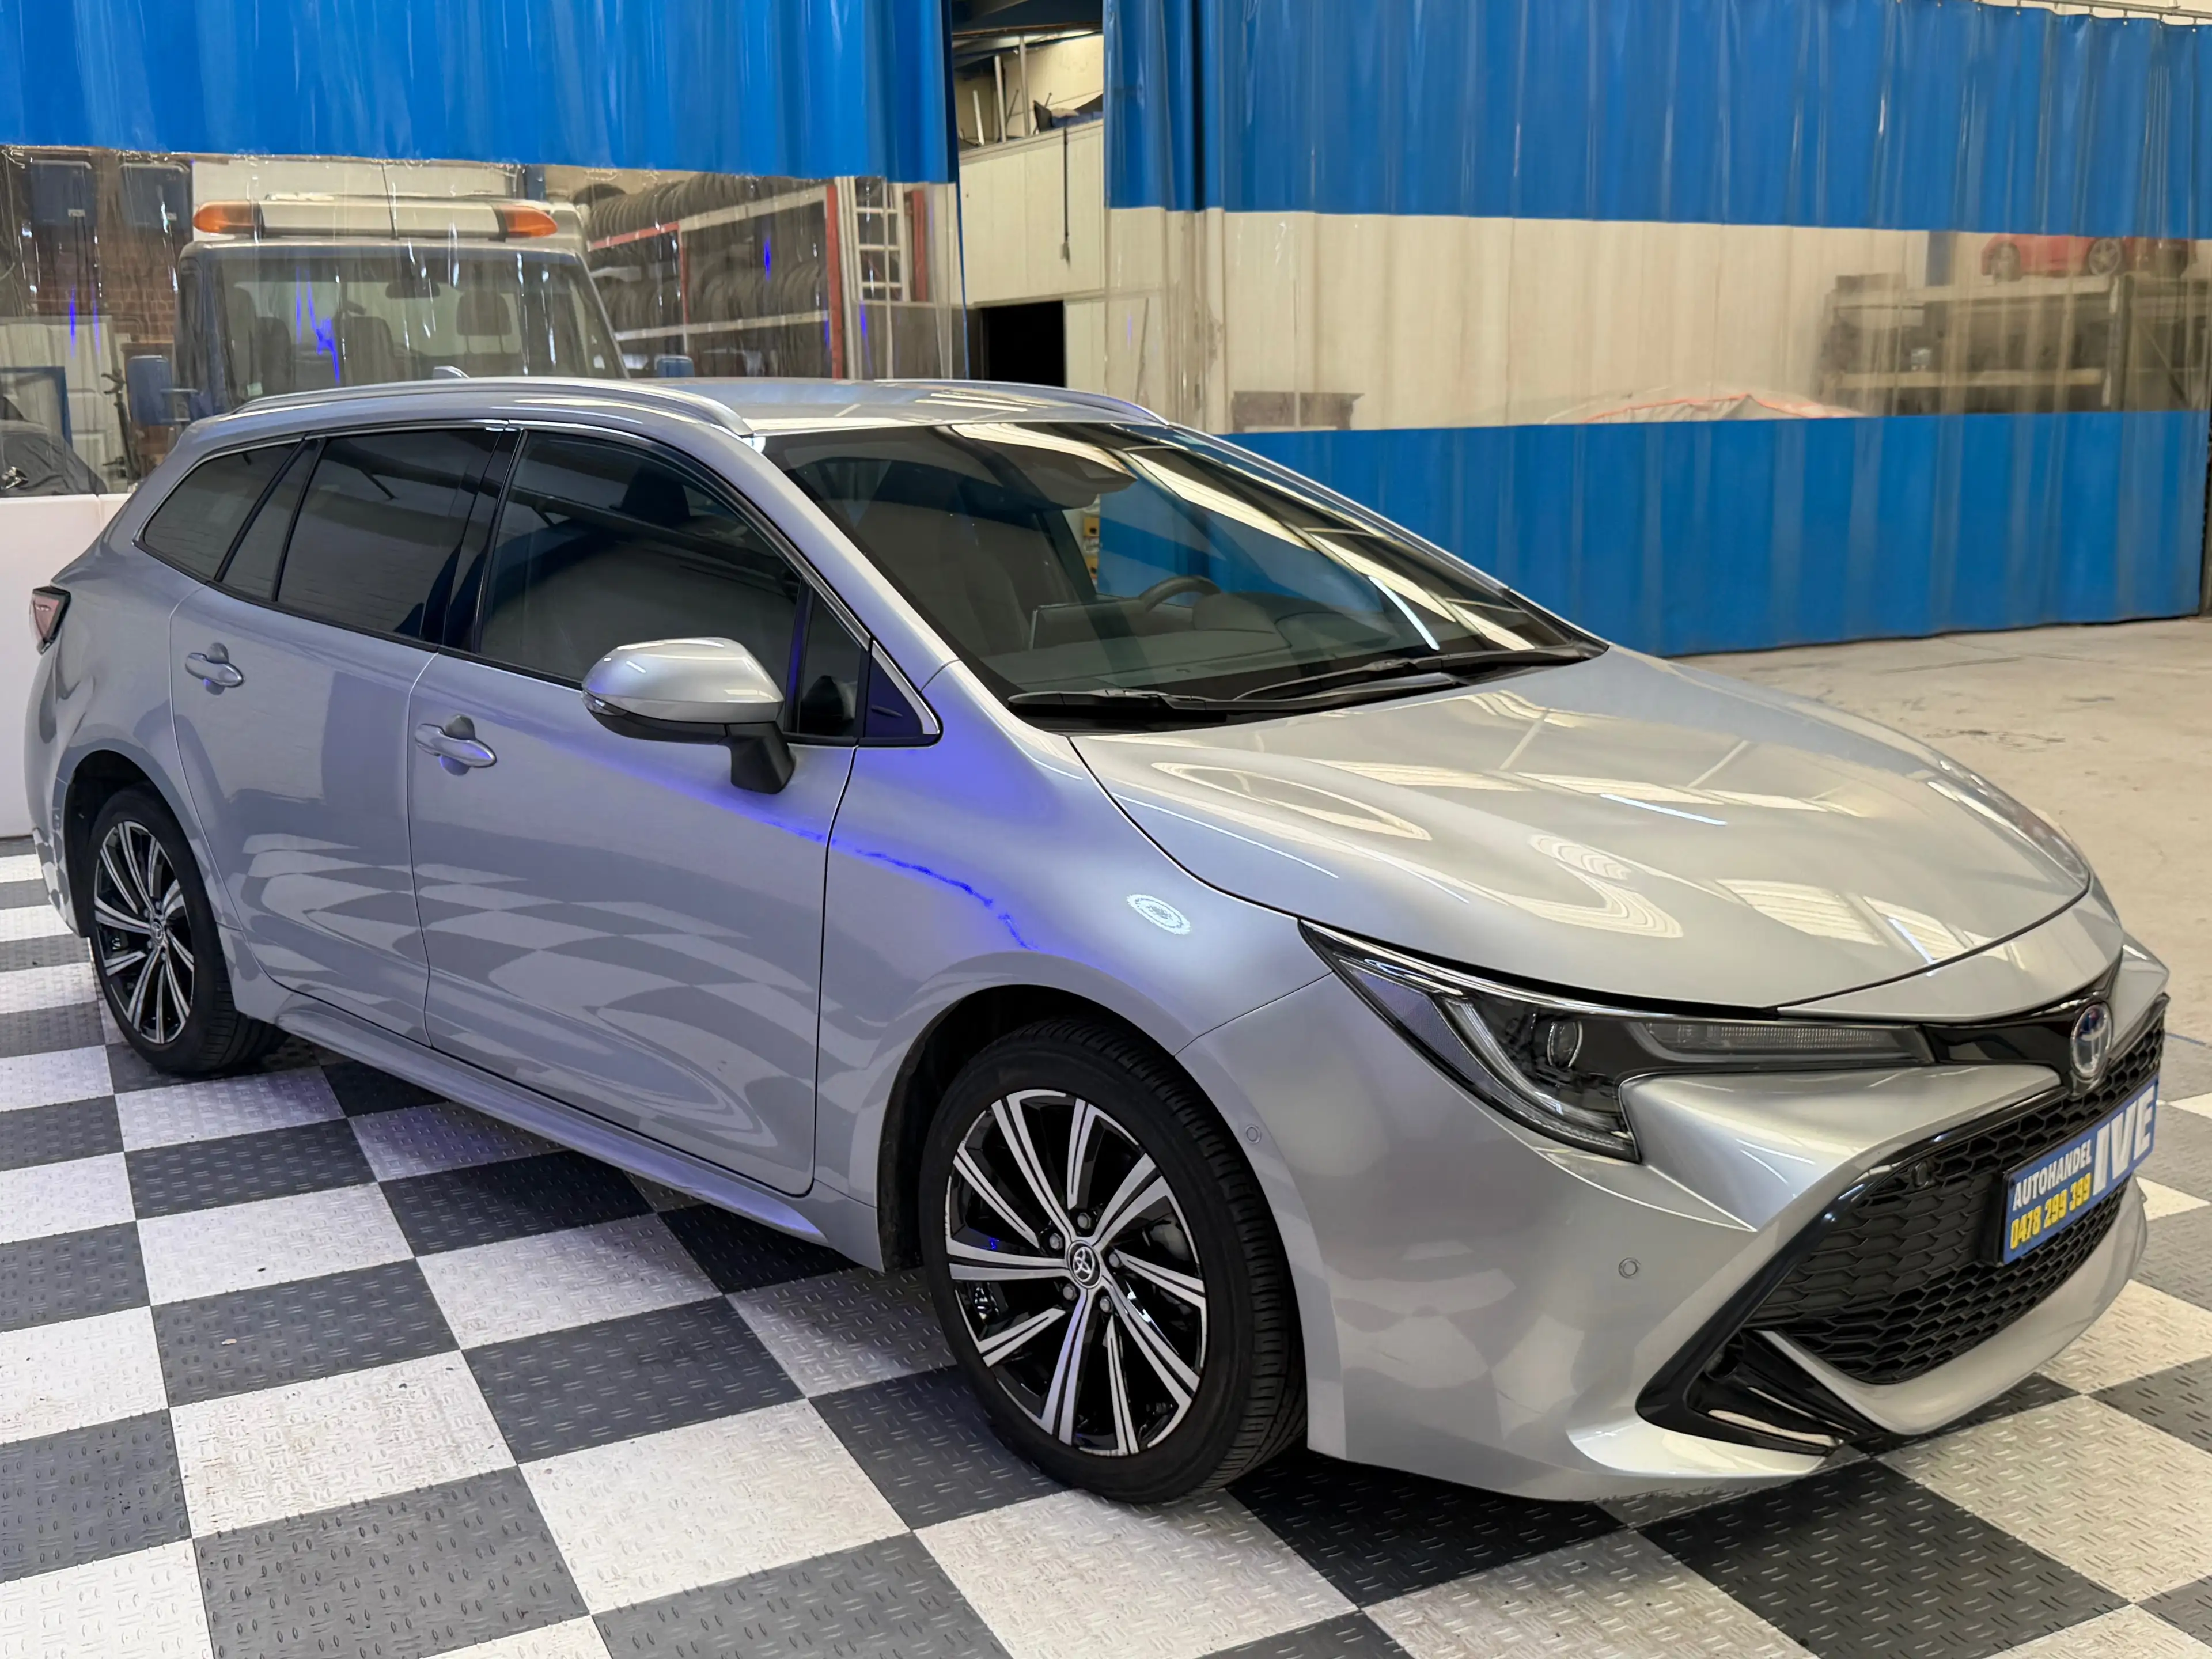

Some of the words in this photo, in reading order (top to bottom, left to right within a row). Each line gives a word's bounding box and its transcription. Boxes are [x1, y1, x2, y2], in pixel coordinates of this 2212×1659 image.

[2013, 1139, 2092, 1211] AUTOHANDEL
[2093, 1085, 2154, 1196] IVE
[2010, 1205, 2042, 1249] 0478
[2044, 1188, 2067, 1228] 299
[2069, 1172, 2092, 1211] 399
